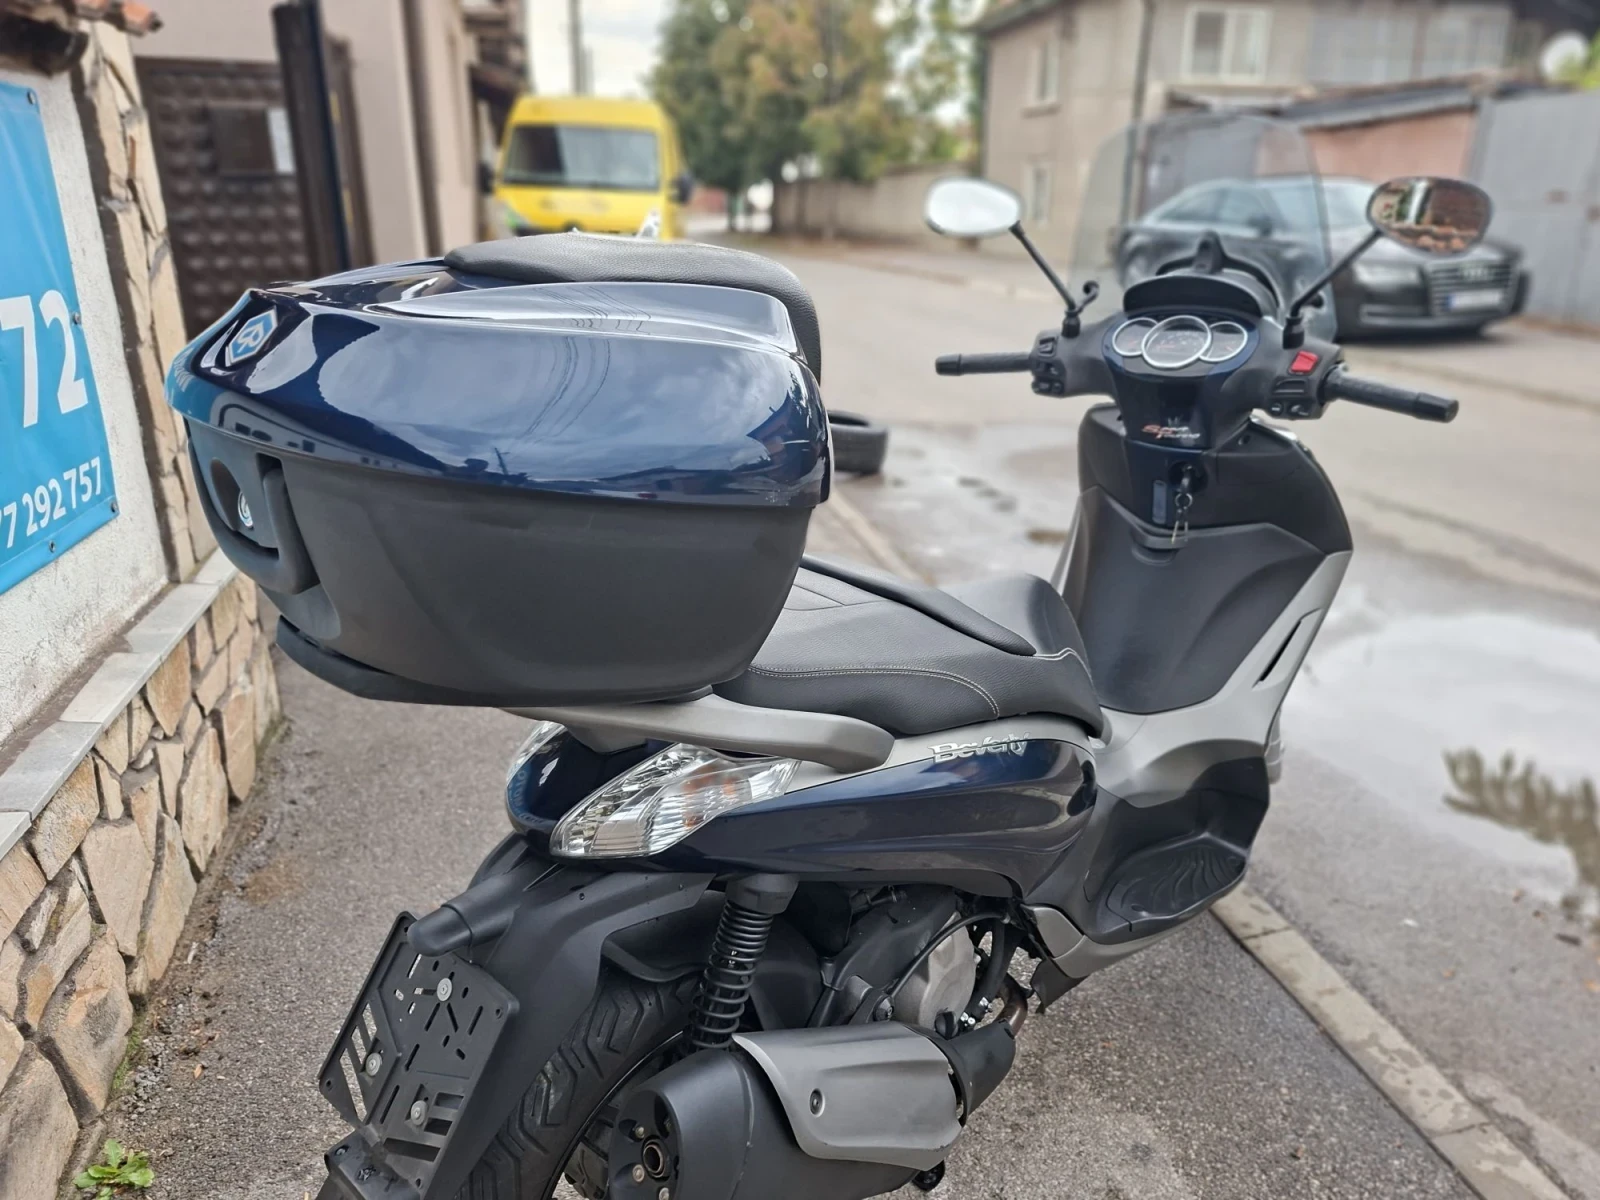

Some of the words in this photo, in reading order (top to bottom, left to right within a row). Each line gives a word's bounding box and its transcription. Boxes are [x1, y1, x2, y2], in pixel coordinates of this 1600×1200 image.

[0, 290, 88, 428] 72
[0, 501, 17, 549] 7
[22, 478, 67, 537] 292
[63, 456, 101, 510] 757
[928, 732, 1030, 763] Beverly
